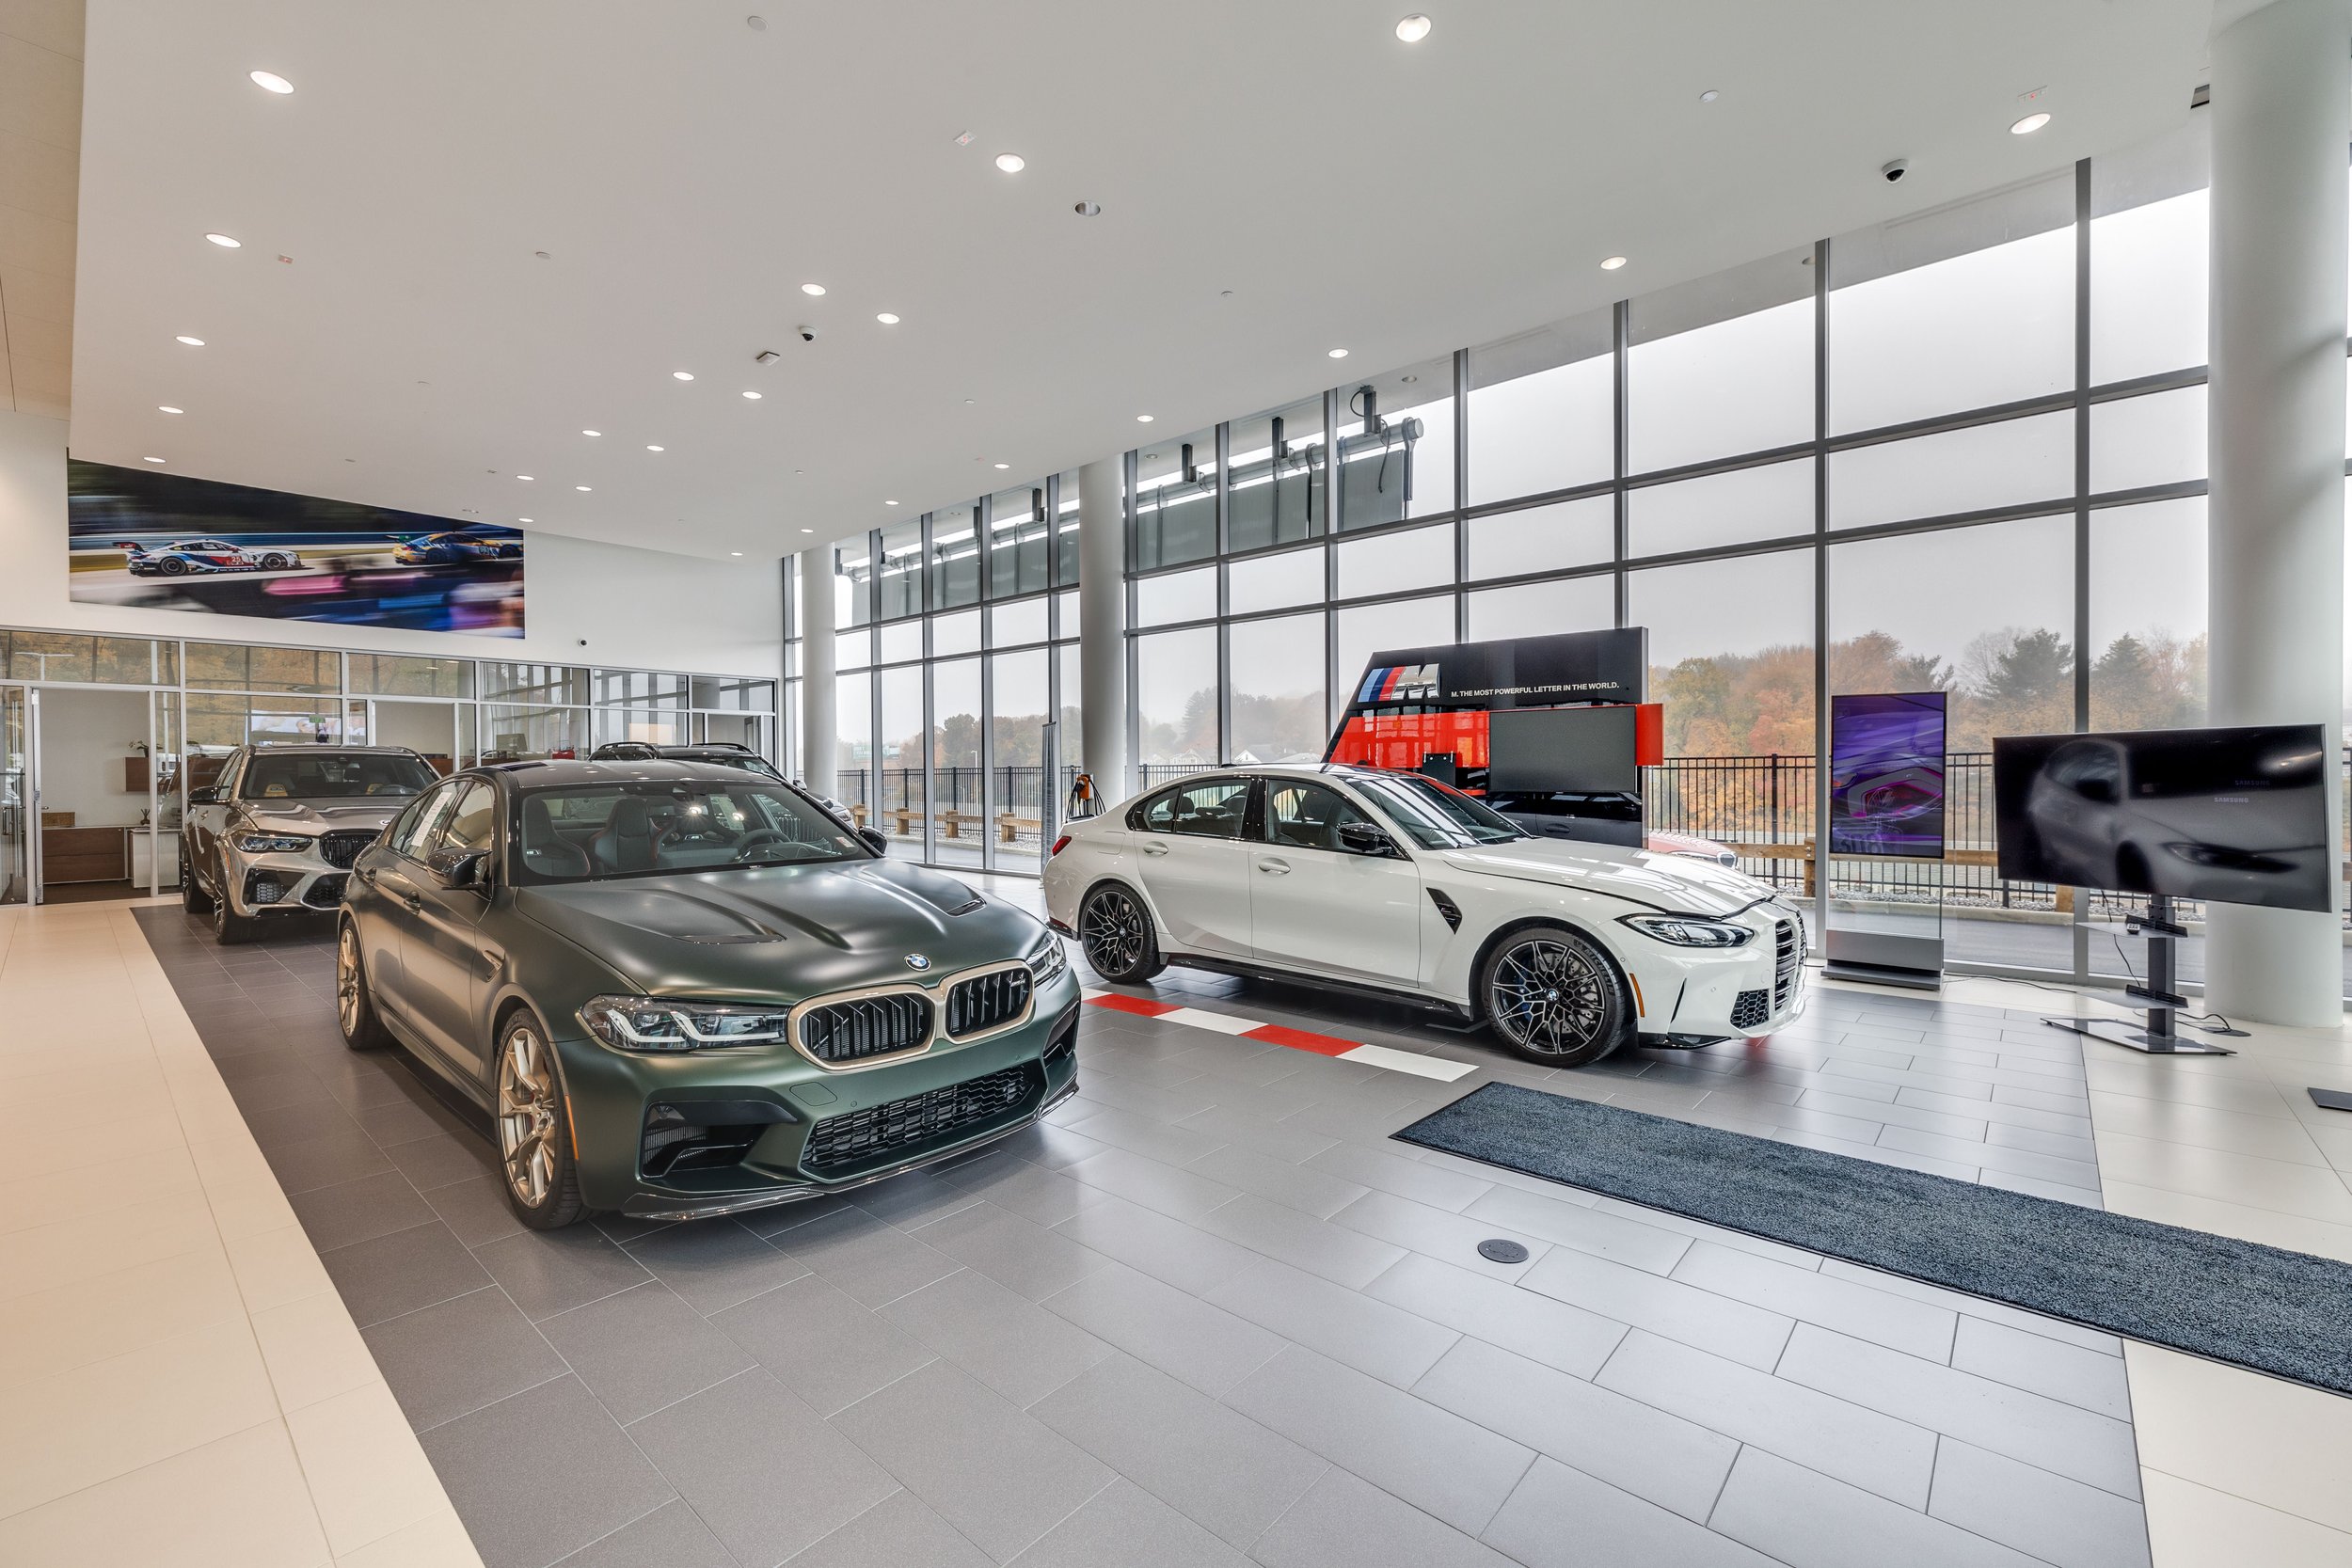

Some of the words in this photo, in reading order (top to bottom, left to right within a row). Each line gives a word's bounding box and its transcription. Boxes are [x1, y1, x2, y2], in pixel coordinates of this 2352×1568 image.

[1473, 689, 1494, 697] MOST
[1494, 687, 1533, 695] POWERFUL
[1534, 685, 1563, 693] LETTER
[1588, 681, 1620, 689] WORLD.
[1584, 947, 1616, 995] MICHELIN
